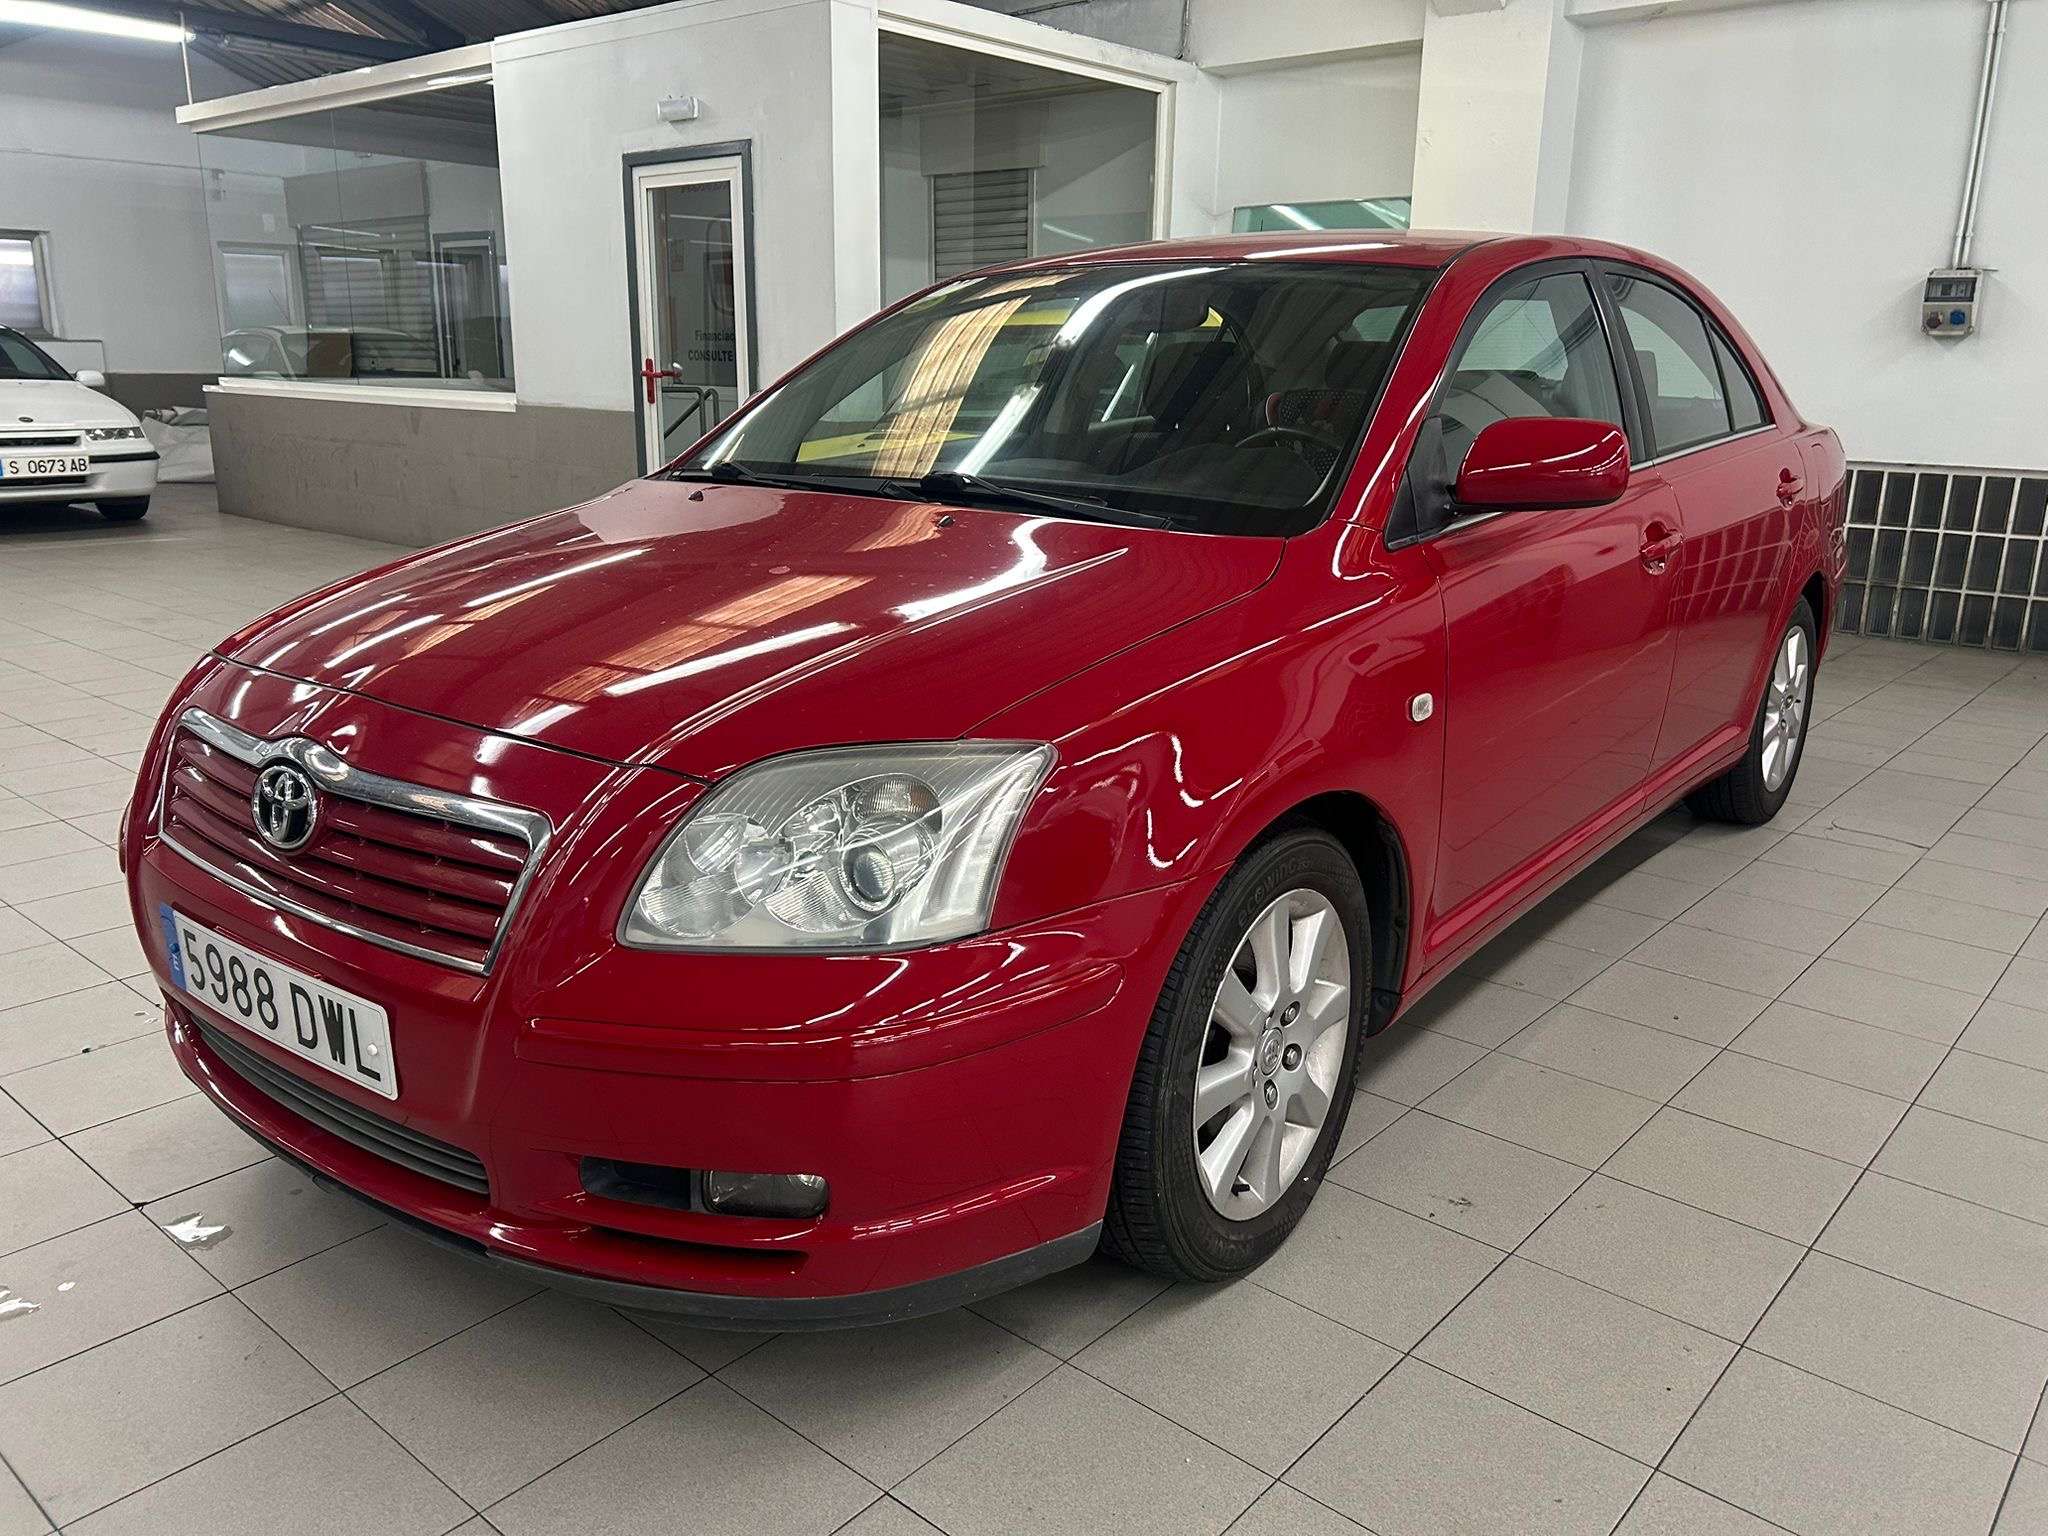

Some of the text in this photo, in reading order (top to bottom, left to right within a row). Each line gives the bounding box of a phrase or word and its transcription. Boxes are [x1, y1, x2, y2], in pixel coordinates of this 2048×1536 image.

[688, 349, 735, 362] CONSULTE
[9, 458, 88, 474] S 0673 AB
[183, 928, 382, 1082] 5988 DWL
